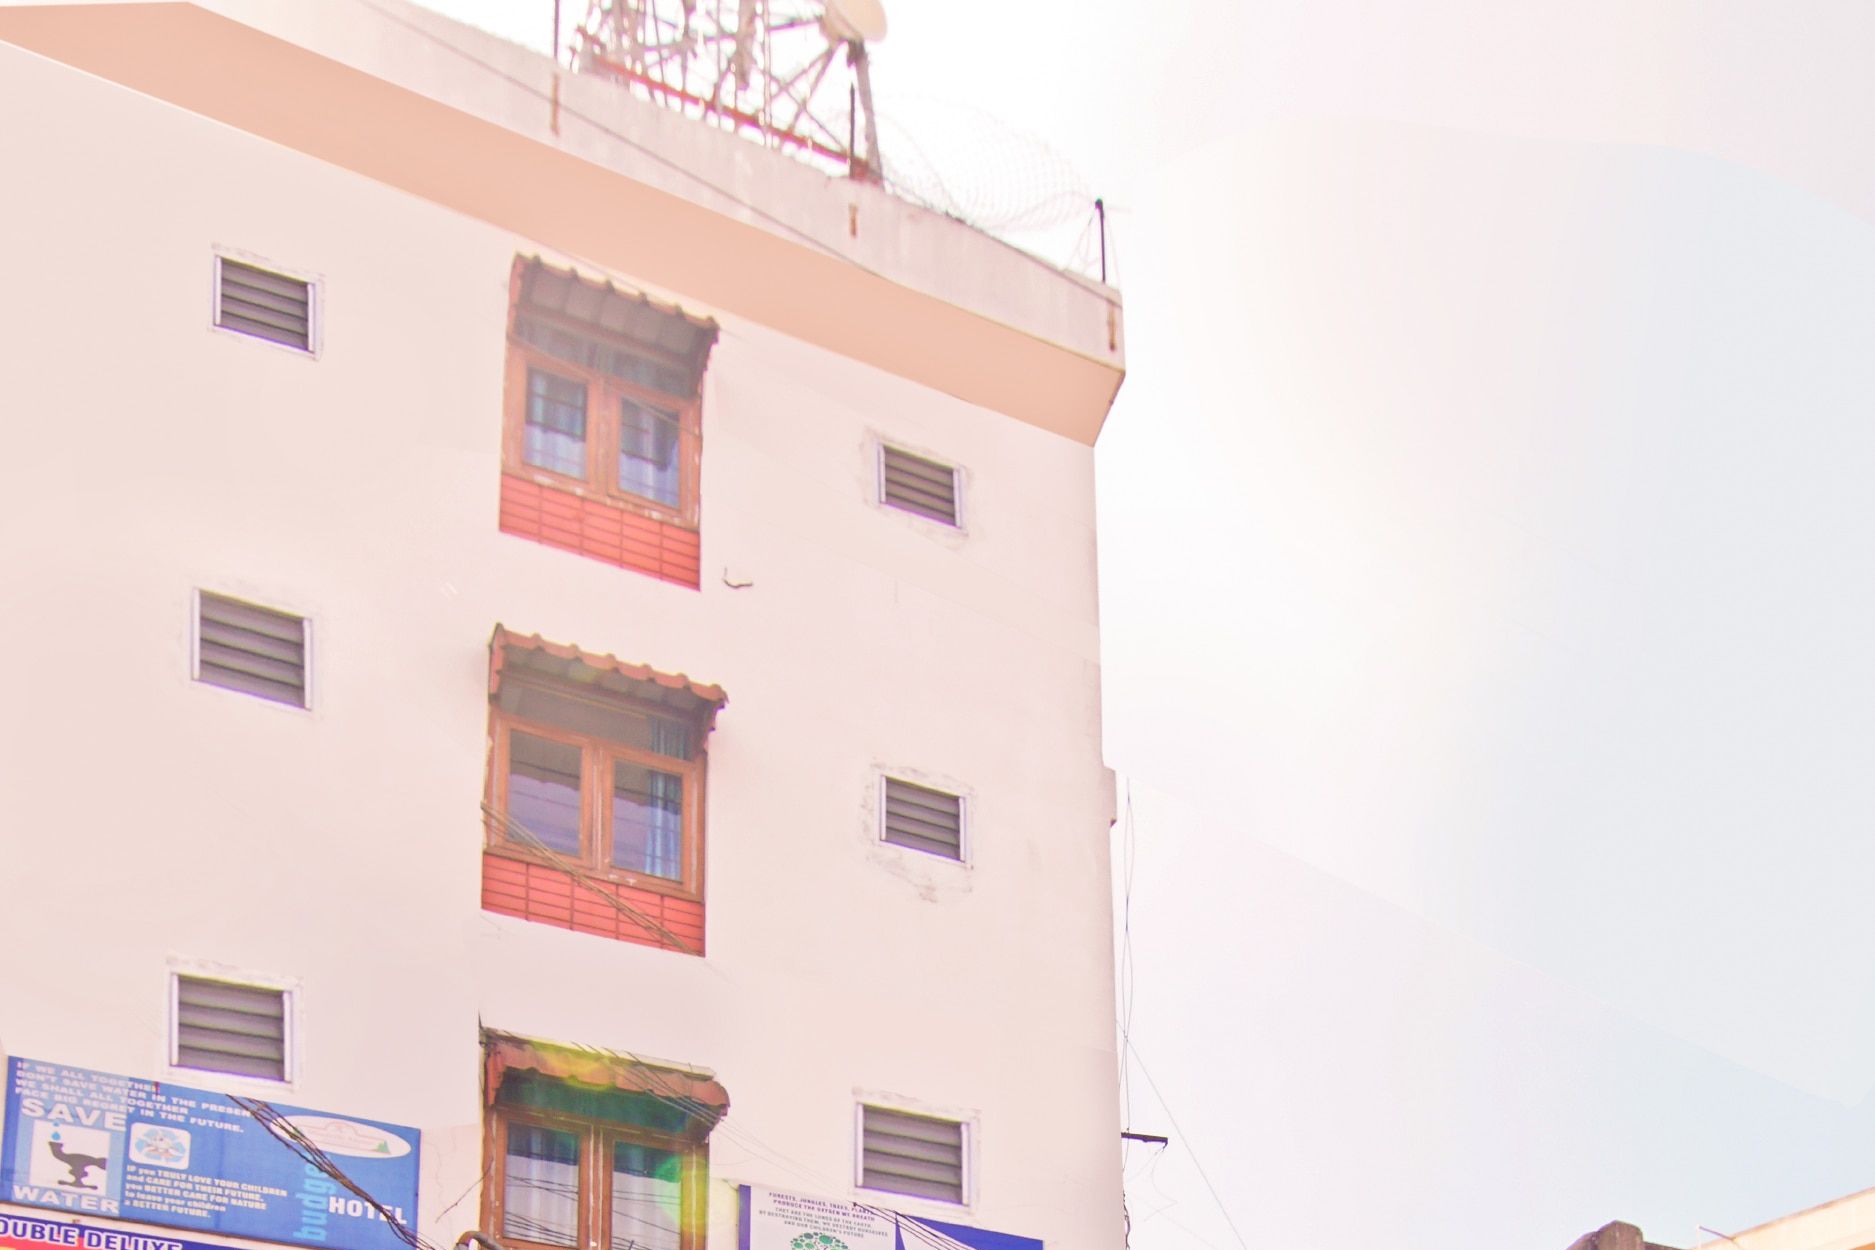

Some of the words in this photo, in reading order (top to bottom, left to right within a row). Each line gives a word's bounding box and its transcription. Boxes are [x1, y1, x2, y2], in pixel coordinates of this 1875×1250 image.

[21, 1098, 127, 1132] SAVE
[140, 1108, 154, 1117] IN
[160, 1111, 185, 1122] THE
[151, 1093, 166, 1102] IN
[171, 1097, 196, 1108] THE
[202, 1103, 252, 1118] PRESEN
[13, 1185, 120, 1214] WATER
[293, 1152, 337, 1241] budge
